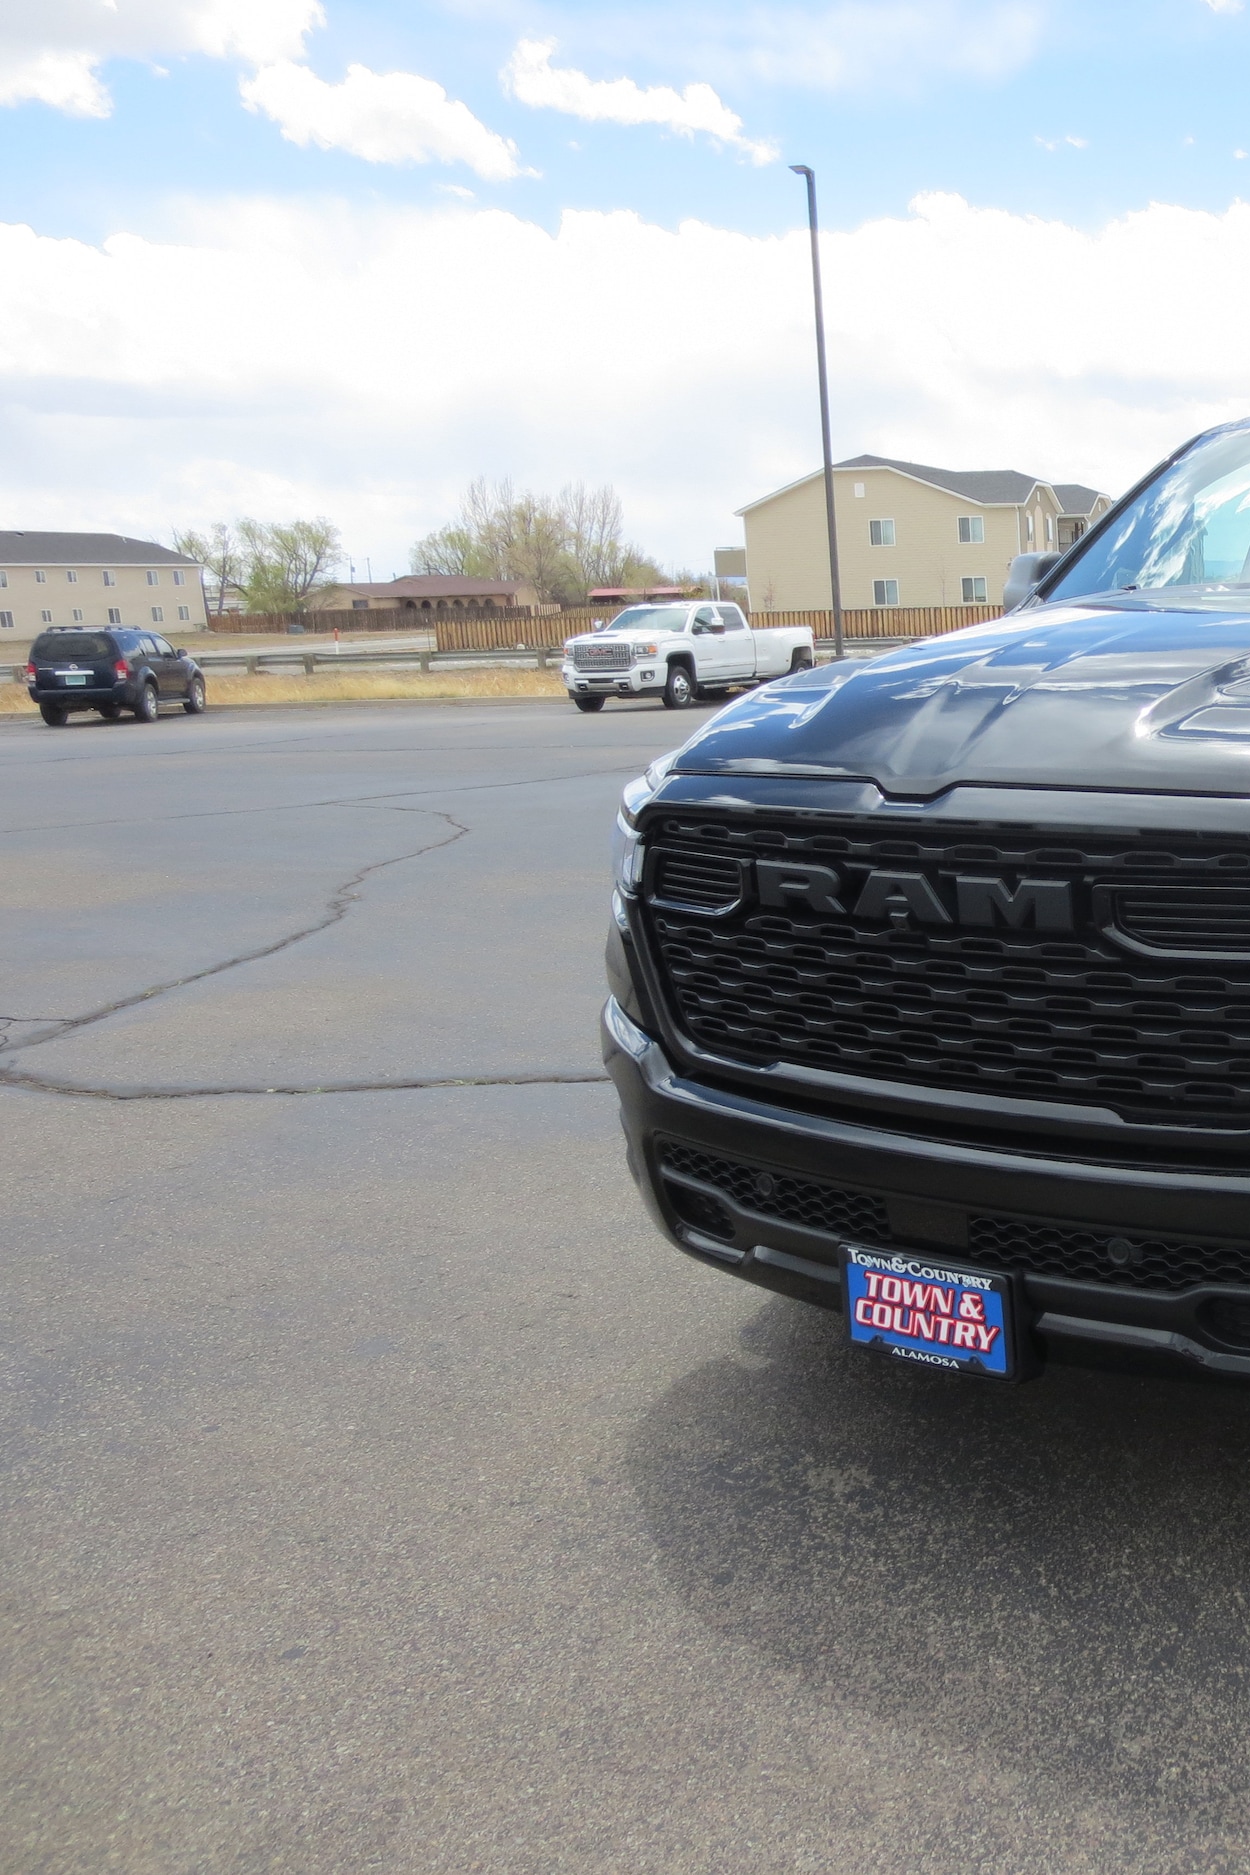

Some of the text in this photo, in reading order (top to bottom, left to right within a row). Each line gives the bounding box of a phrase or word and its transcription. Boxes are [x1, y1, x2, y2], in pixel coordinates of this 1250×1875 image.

[754, 858, 1074, 931] RAM
[864, 1271, 986, 1323] TOWN &
[855, 1298, 1000, 1352] COUNTRY
[891, 1346, 960, 1369] ALAMOSA
